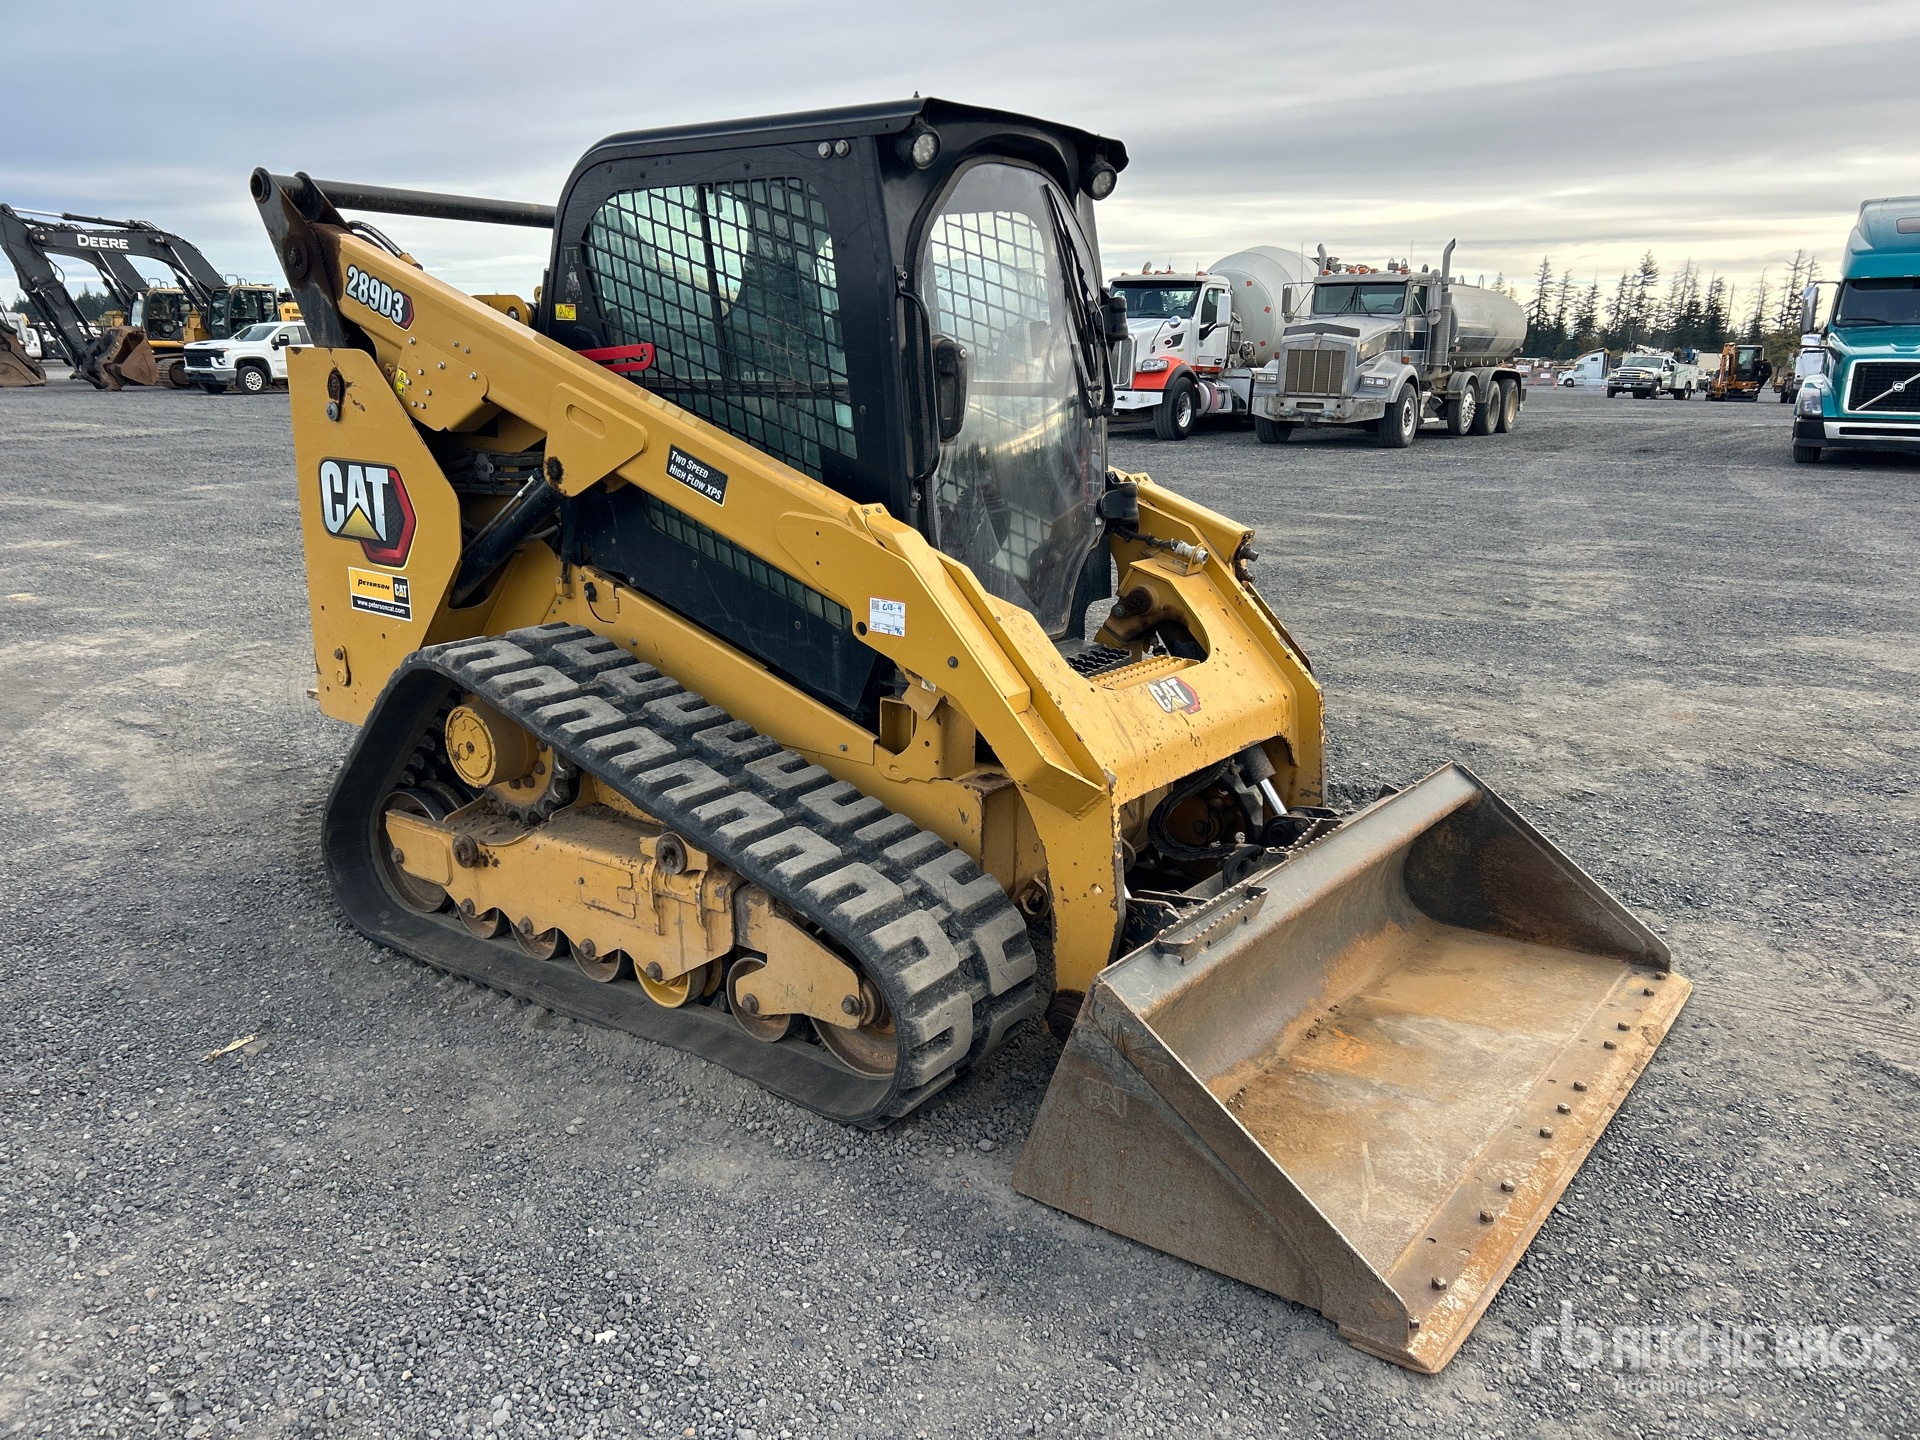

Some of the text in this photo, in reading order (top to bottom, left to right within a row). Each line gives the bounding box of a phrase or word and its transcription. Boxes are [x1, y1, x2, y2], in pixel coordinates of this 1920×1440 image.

[76, 233, 129, 249] DEERE
[346, 265, 404, 323] 289D3
[705, 484, 723, 500] XPS
[319, 460, 389, 542] CAT
[357, 578, 390, 591] PETERSON
[394, 583, 407, 598] CAT
[356, 599, 406, 615] www.petersoncat.com
[1147, 678, 1191, 713] CAT
